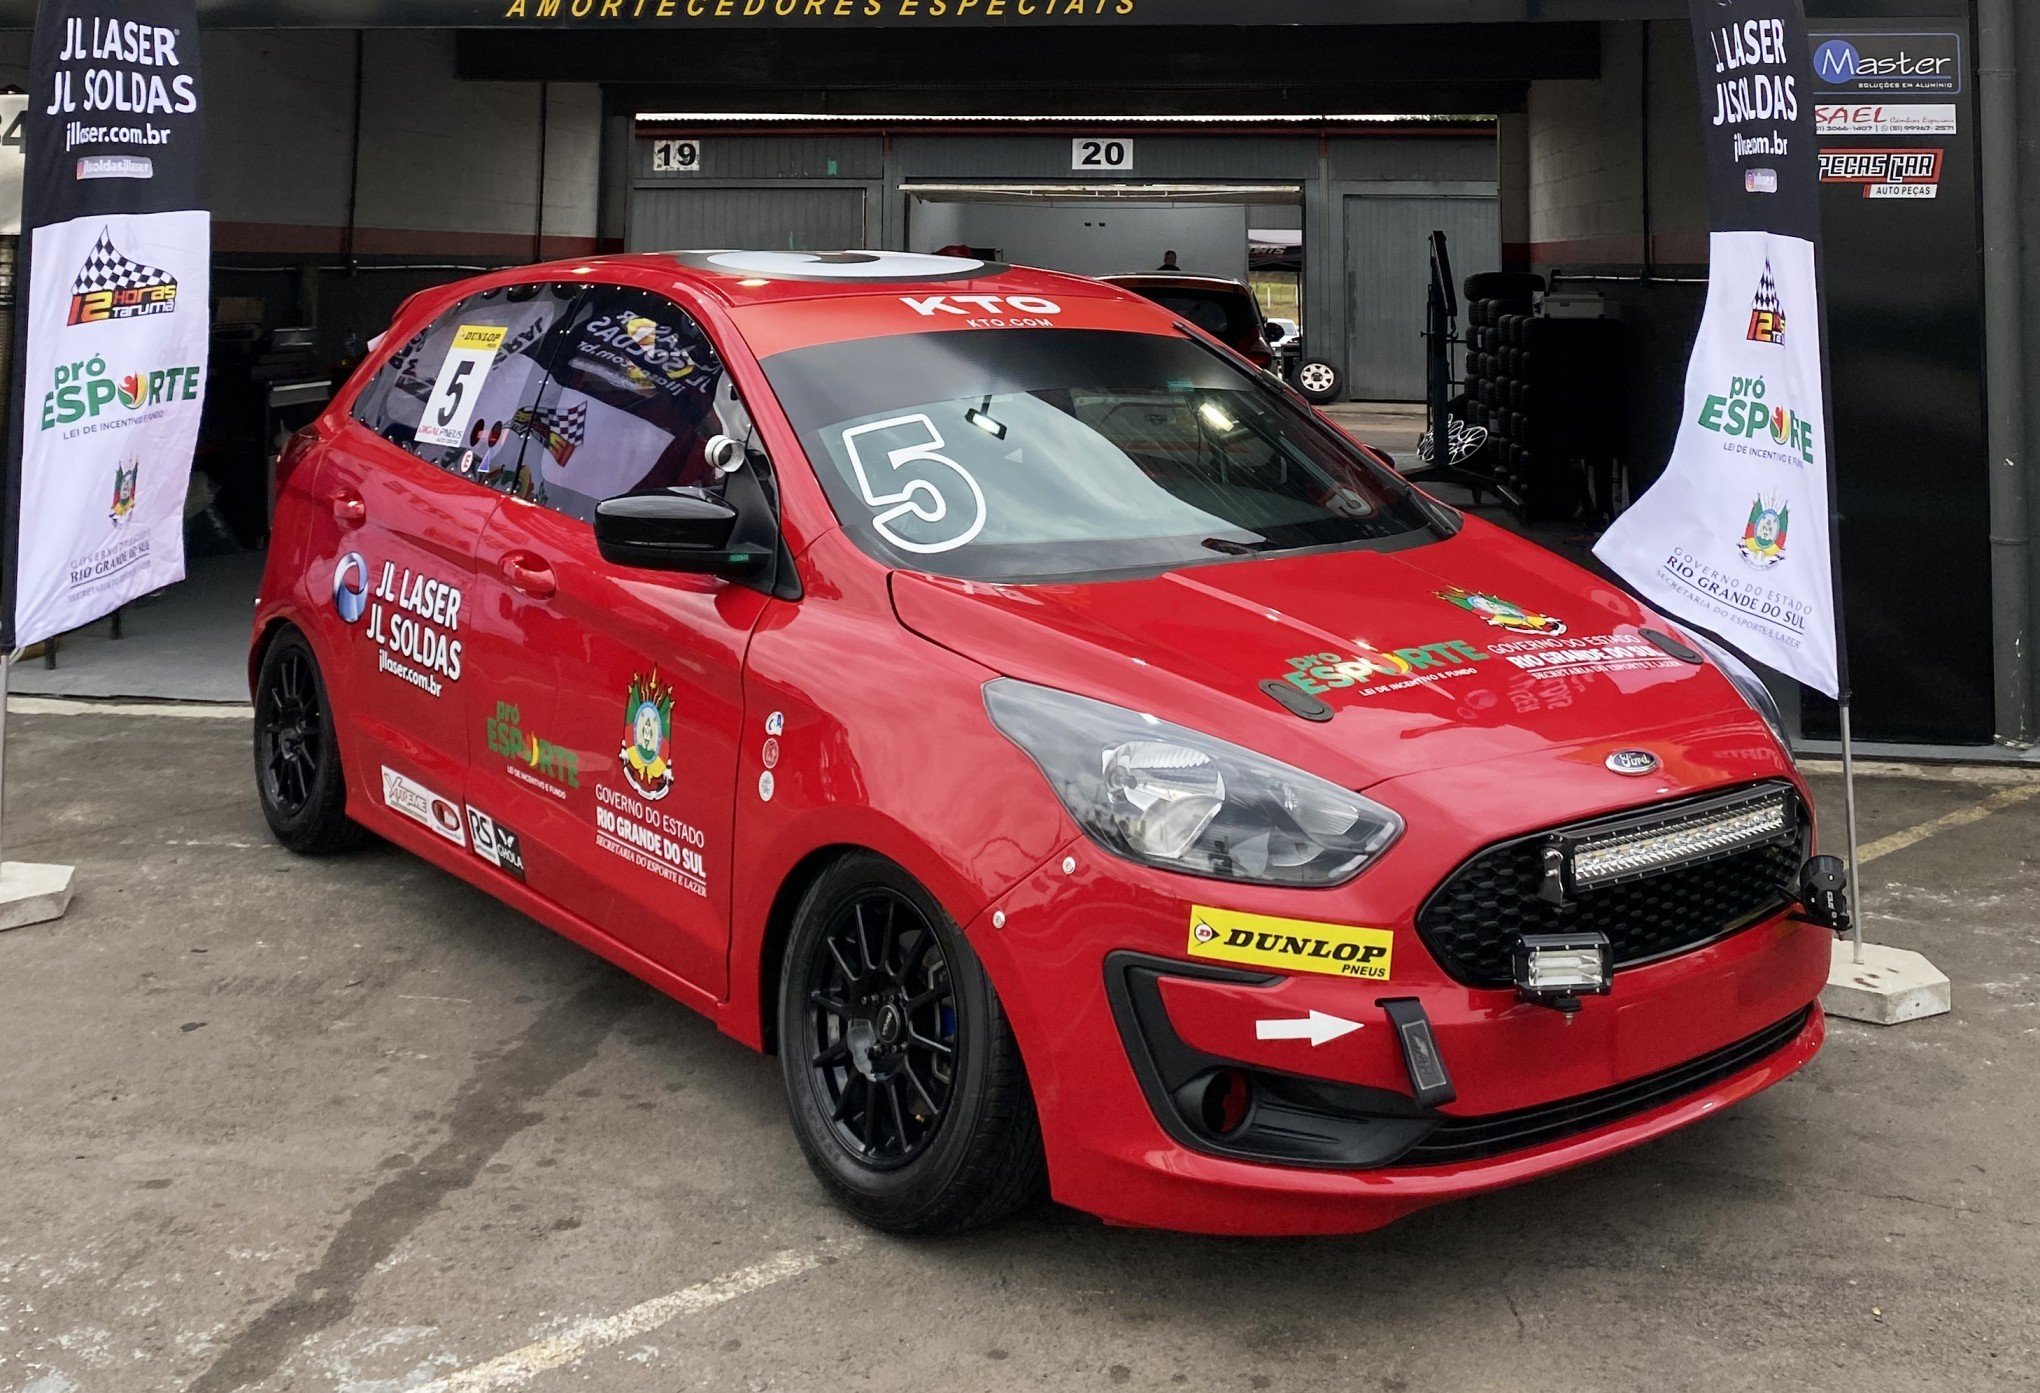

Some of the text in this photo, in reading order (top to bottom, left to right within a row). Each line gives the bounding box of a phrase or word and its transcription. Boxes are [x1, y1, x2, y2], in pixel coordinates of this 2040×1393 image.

[60, 17, 179, 66] JL LASER
[1721, 19, 1786, 69] LASER
[1822, 48, 1951, 75] Master
[47, 68, 197, 115] JL SOLDAS
[657, 143, 696, 166] 19
[1081, 142, 1124, 165] 20
[1887, 154, 1935, 183] CAR
[1876, 186, 1931, 197] AUTO PEÇAS
[66, 289, 113, 327] 12
[899, 295, 1061, 315] KTO
[464, 331, 501, 342] DUNLOP
[966, 319, 1053, 327] KTO.COM
[437, 360, 476, 427] 5
[1730, 374, 1766, 399] pró
[63, 428, 80, 440] LEI
[83, 424, 97, 435] DE
[1723, 442, 1735, 451] LEI
[1737, 445, 1748, 454] DE
[842, 413, 987, 554] 5
[70, 566, 92, 583] RIO
[1674, 547, 1739, 588] GOVERNO
[1745, 583, 1763, 596] DO
[1768, 590, 1813, 615] ESTADO
[376, 560, 462, 631] JL LASER
[1666, 555, 1806, 630] RIO GRANDE DO SUL
[366, 603, 462, 681] JL SOLDAS
[1487, 637, 1562, 655] GOVERNO
[1560, 637, 1586, 648] DO
[1506, 654, 1545, 669] RIO
[1543, 648, 1612, 664] GRANDE
[378, 649, 442, 698] jllaser.com.br
[1359, 686, 1375, 697] LEI
[1375, 684, 1390, 694] DE
[1390, 673, 1439, 692] INCENTIVO
[1446, 667, 1478, 679] FUNDO
[1619, 753, 1650, 768] Ford
[595, 783, 705, 849] GOVERNO DO ESTADO
[596, 806, 707, 879] RIO GRANDE DO SUL
[595, 834, 635, 863] SECRETARIA
[635, 853, 647, 868] DO
[646, 858, 678, 883] ESPORTE
[683, 878, 707, 898] LAZER
[1223, 928, 1387, 963] DUNLOP
[1341, 963, 1386, 977] PNEUS
